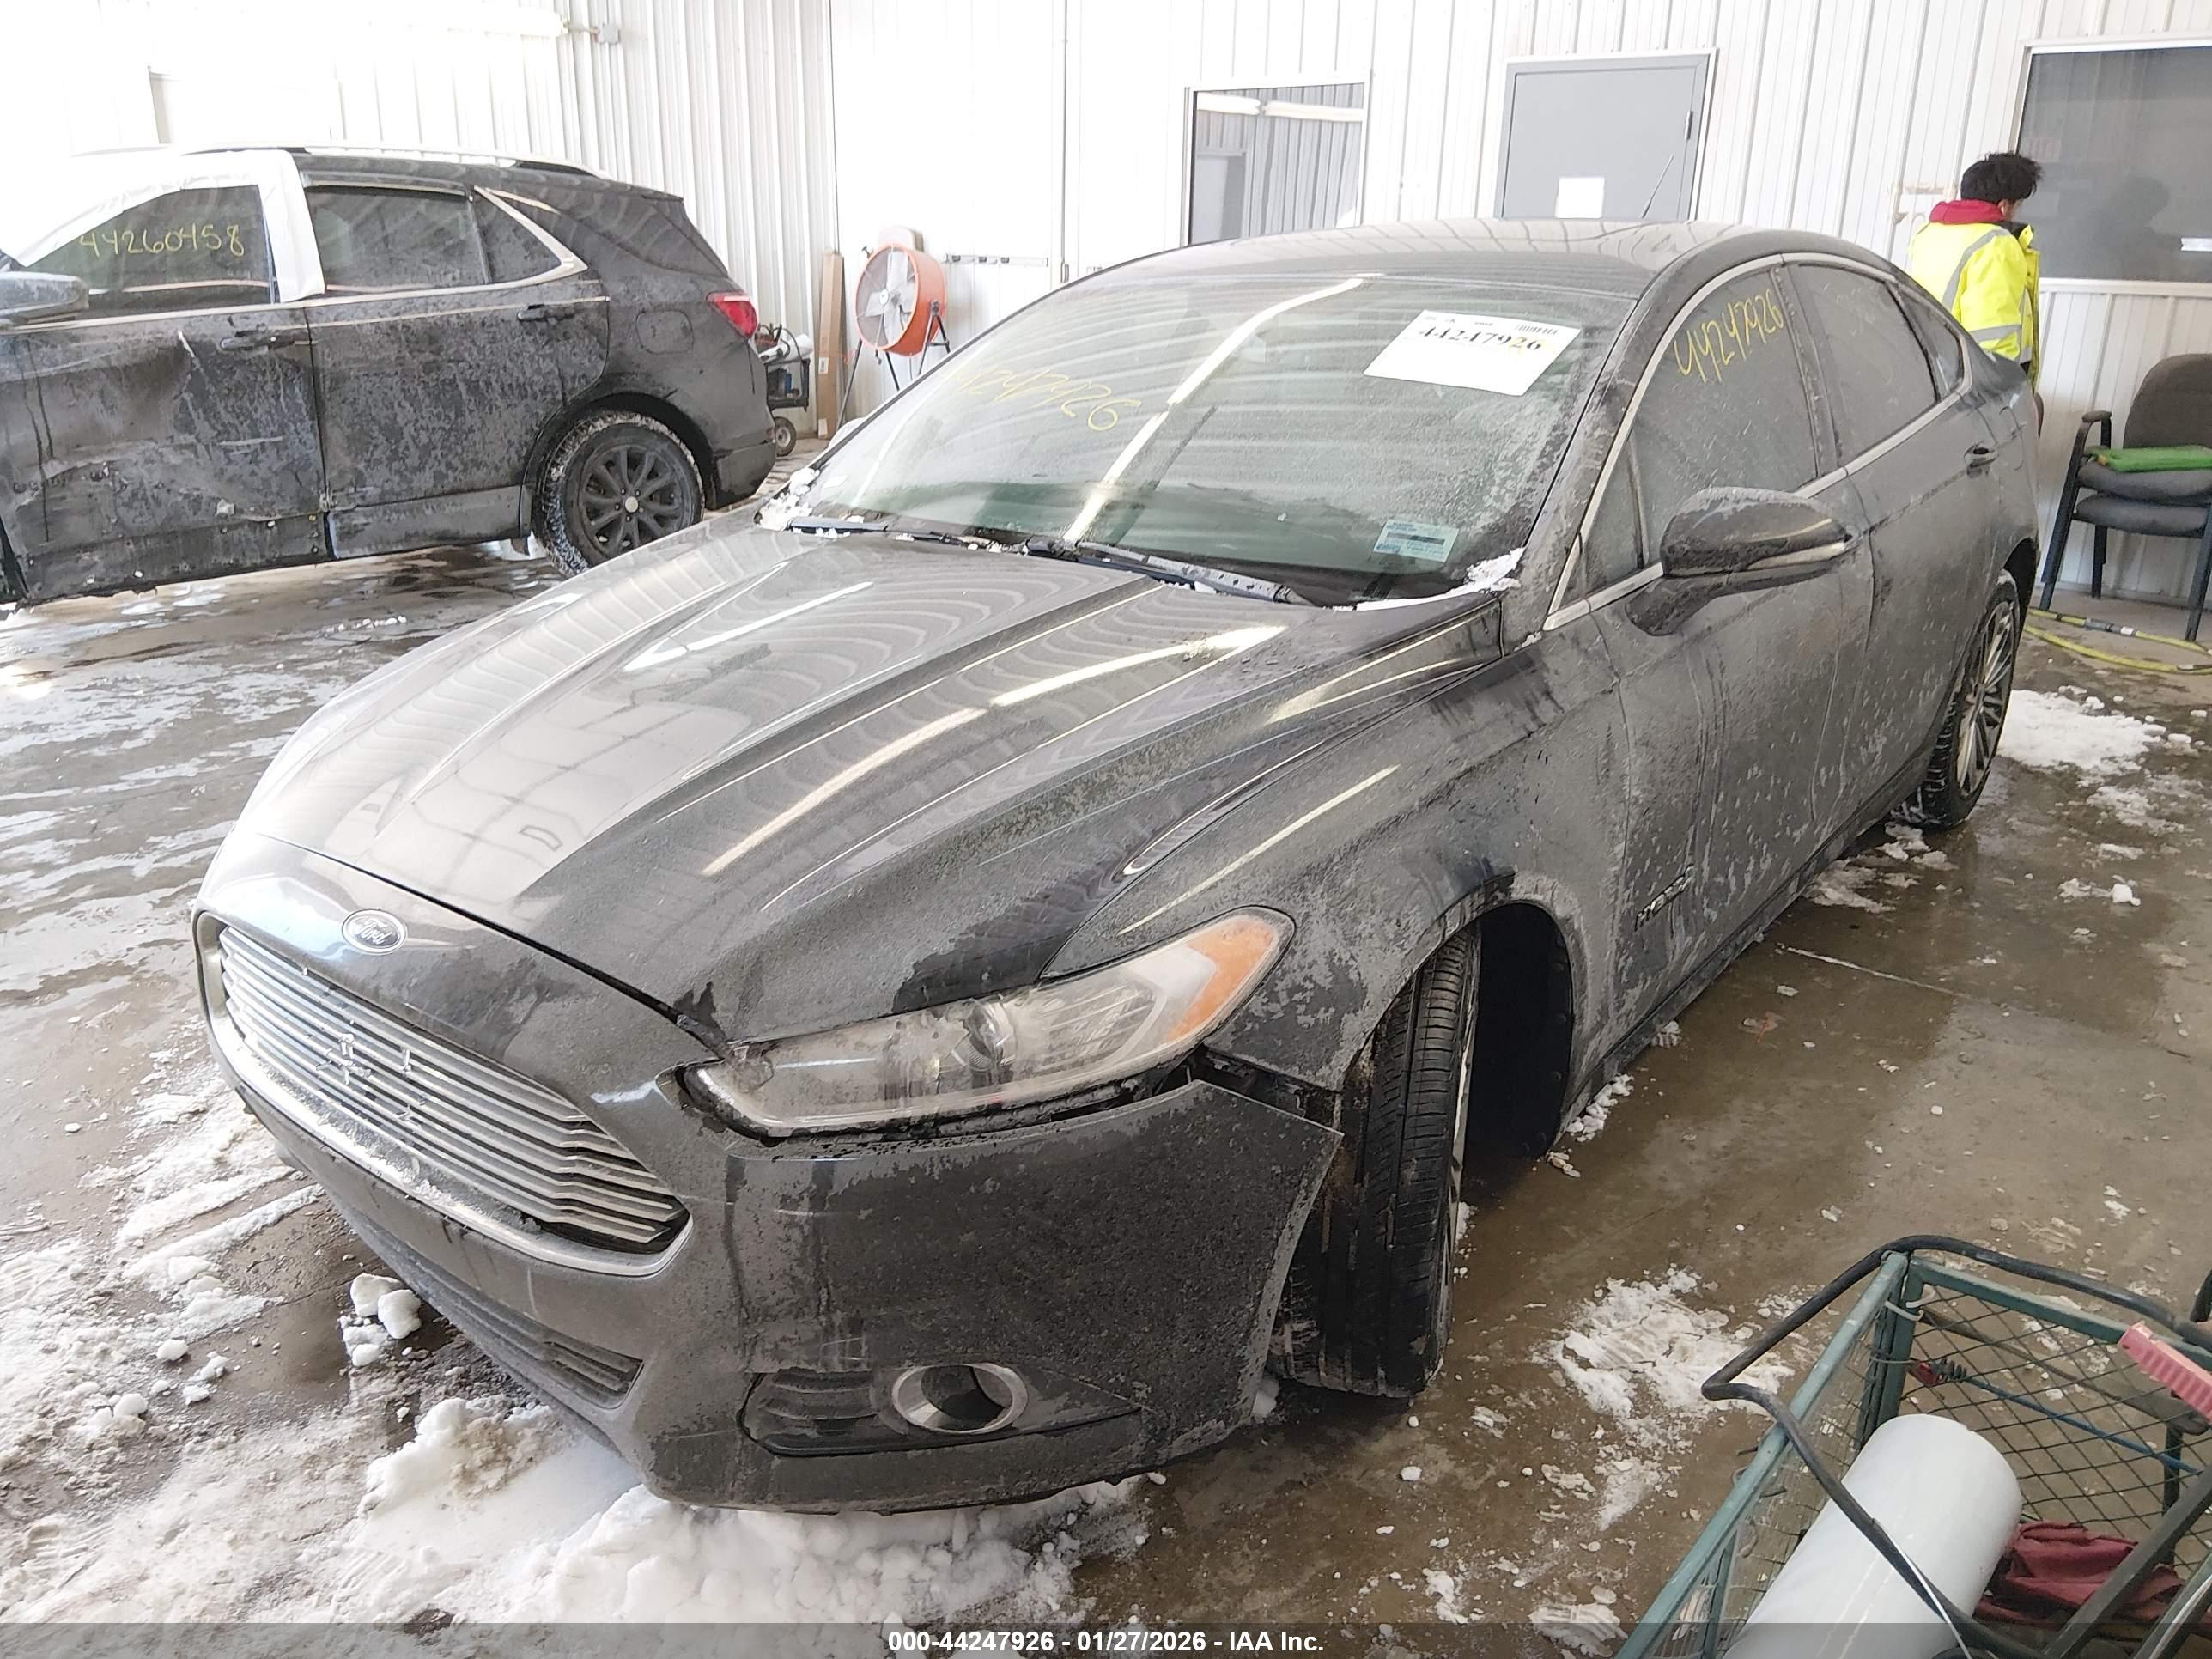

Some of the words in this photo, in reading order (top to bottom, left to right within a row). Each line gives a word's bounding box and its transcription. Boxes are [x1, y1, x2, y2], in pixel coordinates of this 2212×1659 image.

[79, 223, 245, 258] 44260458
[1419, 325, 1542, 351] 44247926
[1674, 289, 1784, 383] 44247926
[951, 364, 1142, 430] 4247926
[349, 917, 393, 945] Ford
